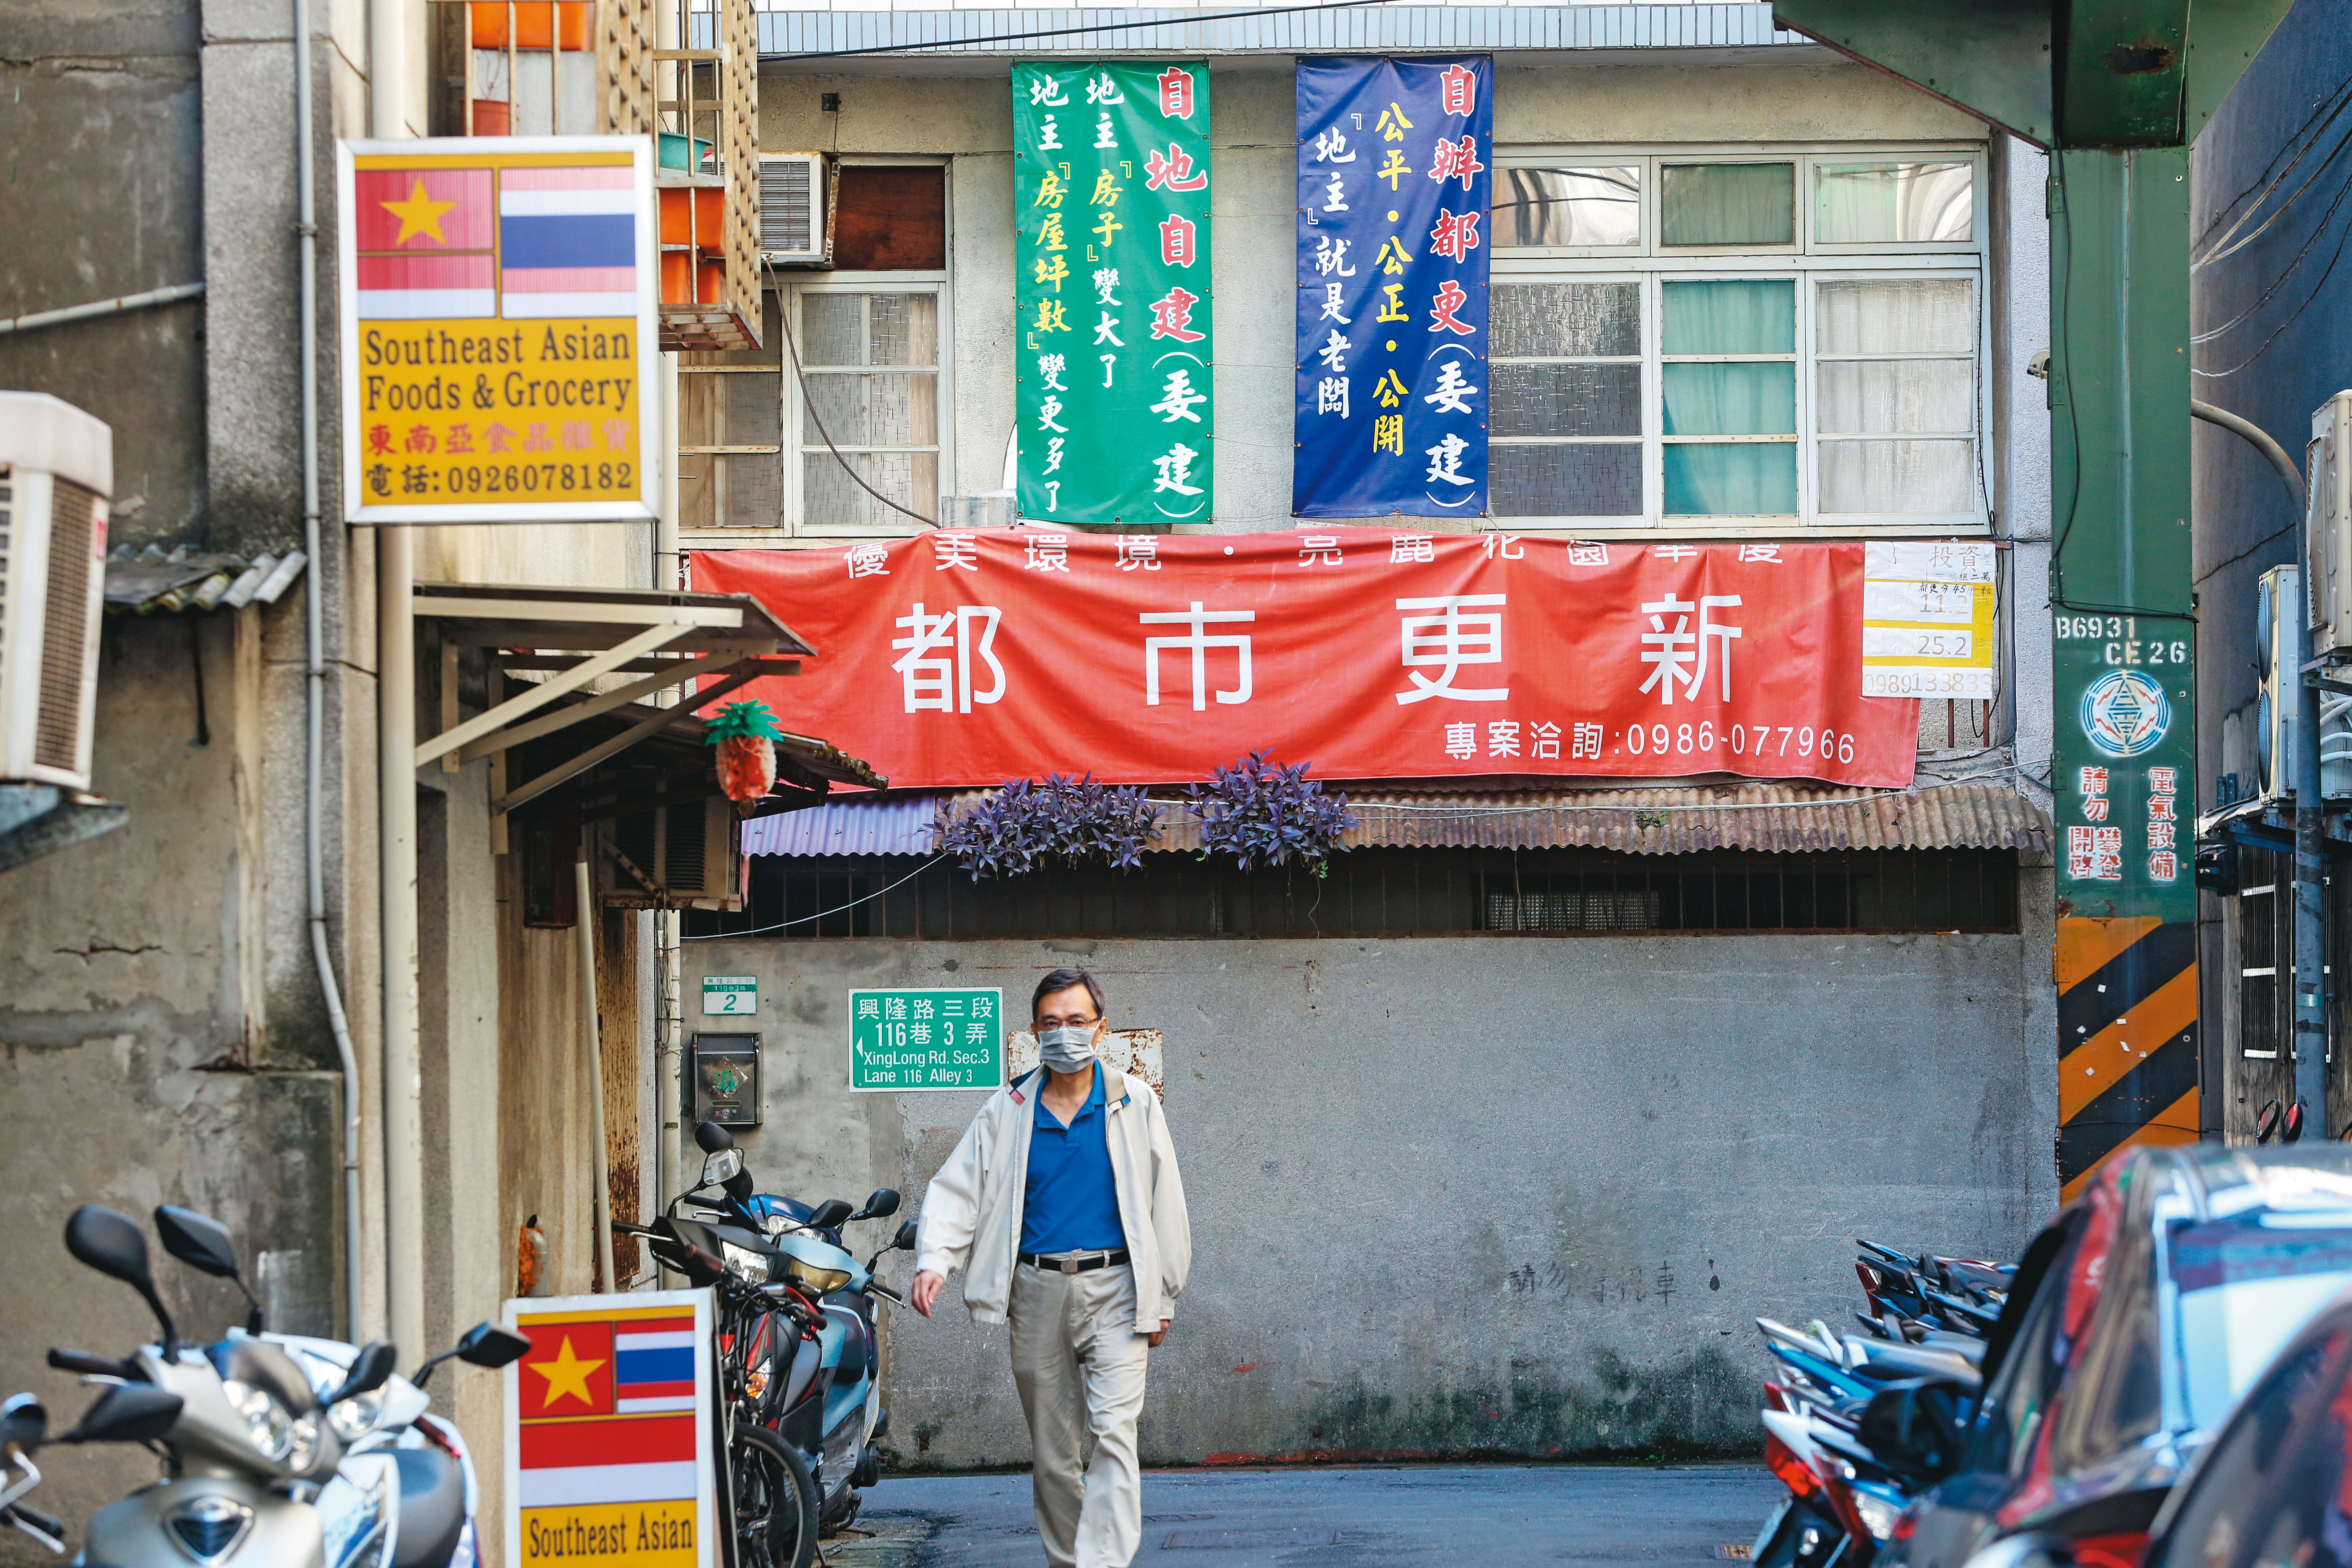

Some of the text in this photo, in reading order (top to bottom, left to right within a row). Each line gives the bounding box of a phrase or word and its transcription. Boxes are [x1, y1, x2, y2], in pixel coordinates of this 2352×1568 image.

[365, 325, 630, 366] Southeast Asian
[367, 371, 632, 412] Foods & Grocery
[366, 419, 630, 457] 東南亞食品雜貨
[1928, 545, 1981, 572] 投資
[1920, 593, 1968, 614] 11.2
[2056, 616, 2135, 639] B6931
[891, 593, 1744, 715] 都市更新
[1918, 635, 1967, 656] 25.2
[723, 994, 737, 1011] 2
[858, 996, 993, 1020] 興隆路三段
[864, 1049, 990, 1067] XingLong Rd. Sec.3
[864, 1069, 973, 1085] Lane 116 Alley 3
[530, 1508, 693, 1558] Southeast Asian
